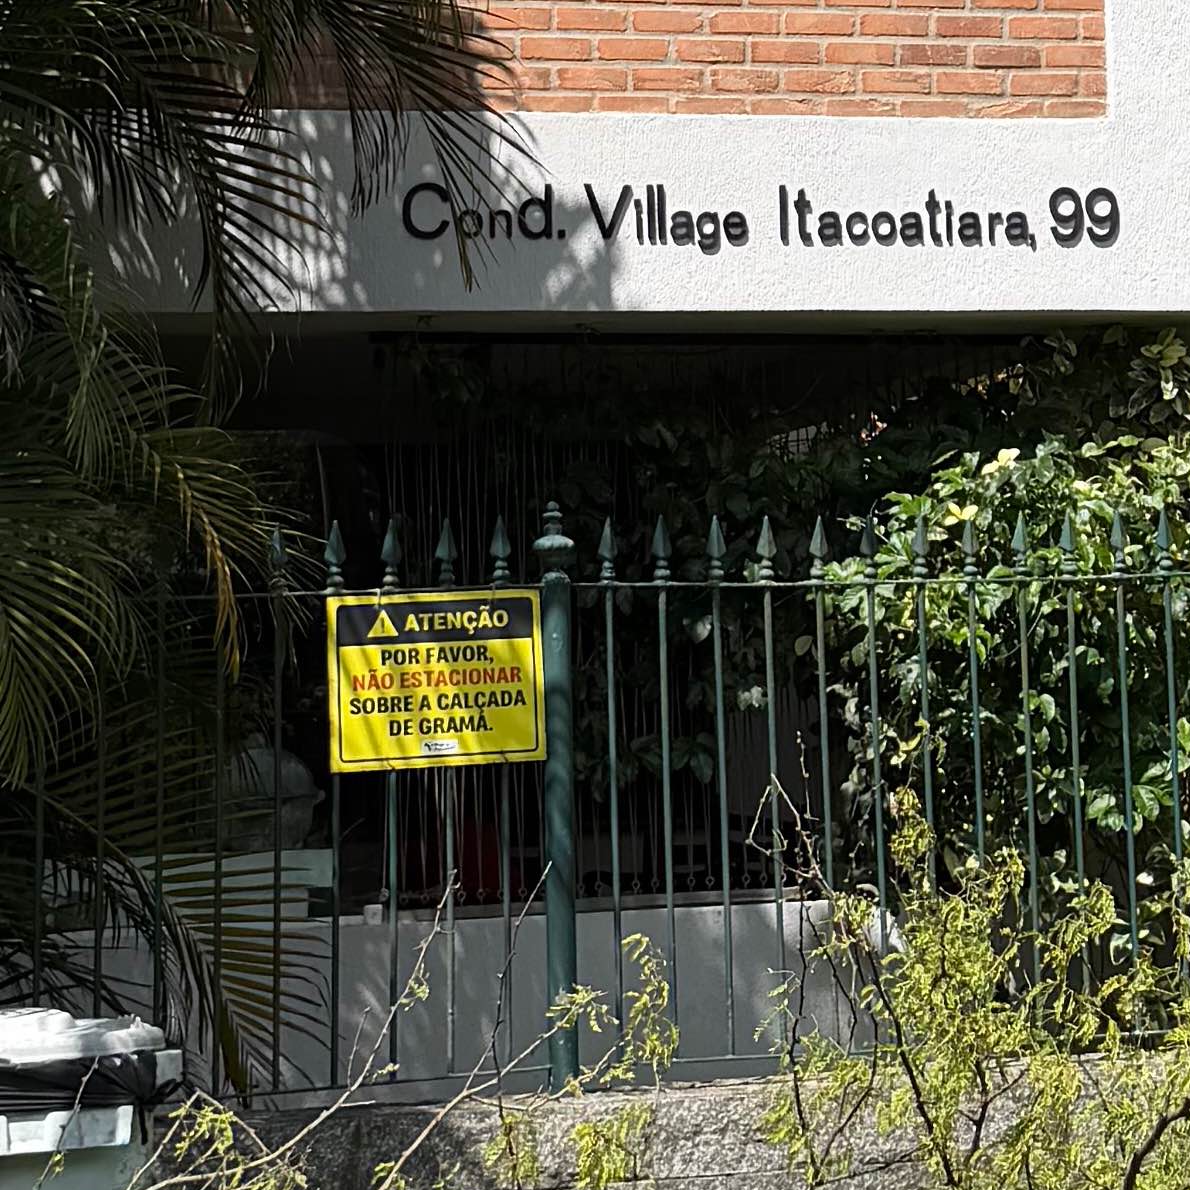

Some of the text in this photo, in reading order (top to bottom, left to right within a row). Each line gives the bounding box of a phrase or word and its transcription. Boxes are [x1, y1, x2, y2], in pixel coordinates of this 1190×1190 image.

[402, 183, 1120, 255] Cond. Village Itacoatiara, 99
[404, 606, 509, 634] ATENÇÃO
[381, 645, 493, 666] POR FAVOR,
[352, 666, 522, 691] NÃO ESTACIONAR
[350, 689, 526, 715] SOBRE A CALÇADA
[389, 719, 413, 736] DE
